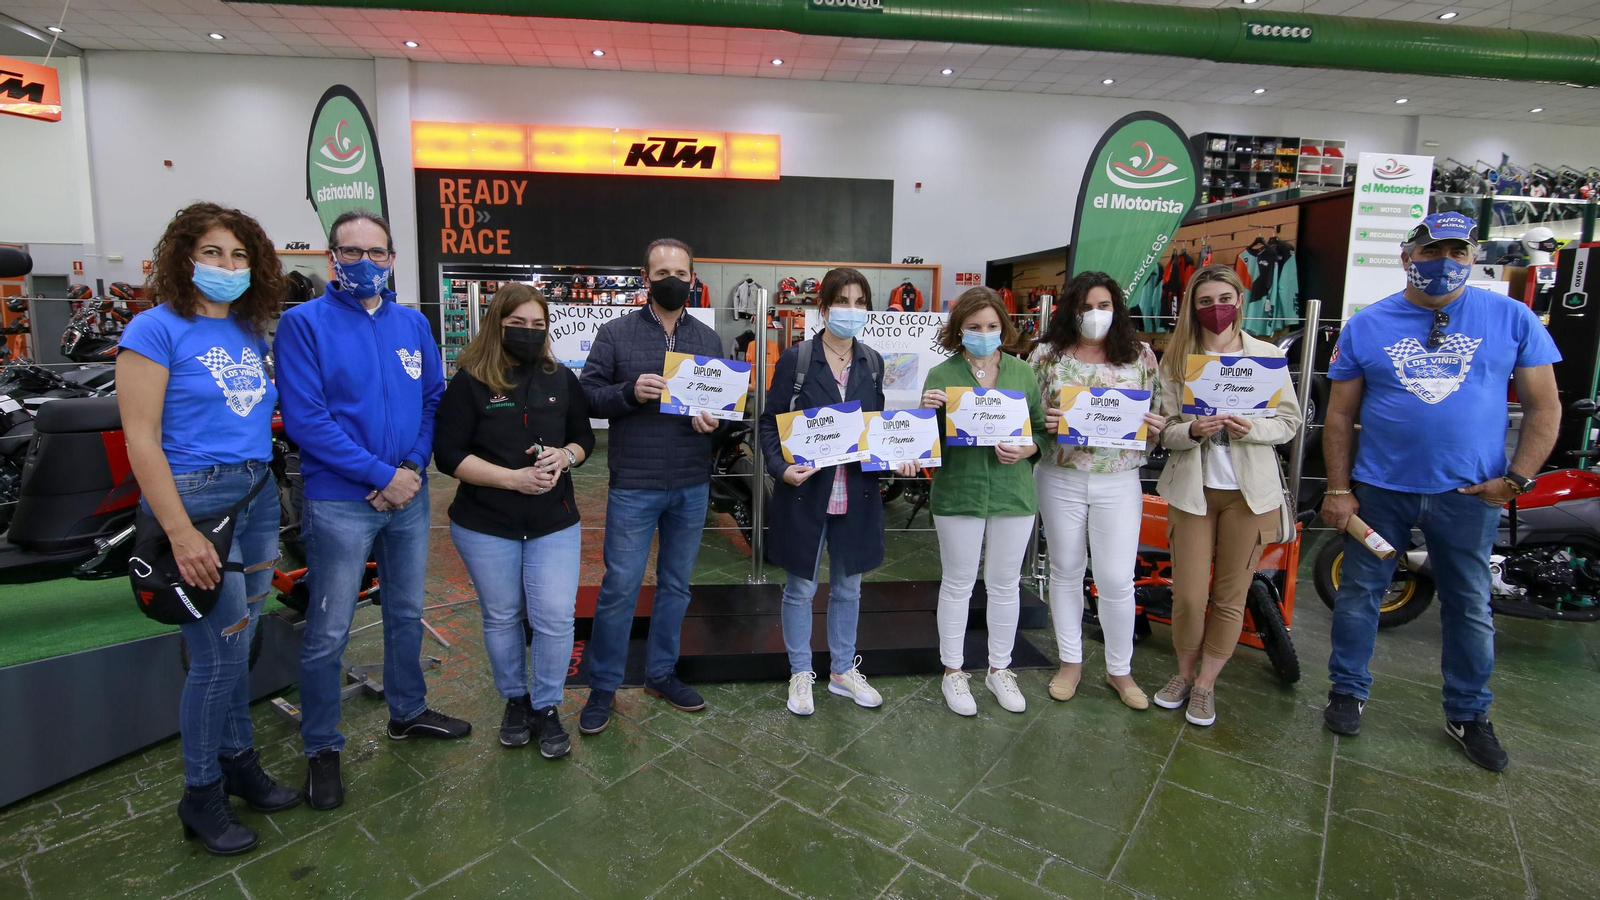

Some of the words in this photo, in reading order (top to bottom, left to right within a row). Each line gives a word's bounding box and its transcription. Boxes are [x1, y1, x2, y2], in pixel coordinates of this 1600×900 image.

[623, 136, 717, 169] KTM
[438, 178, 528, 205] READY
[1361, 182, 1372, 193] el
[1373, 183, 1425, 196] Motorista
[1093, 193, 1109, 209] el
[1110, 193, 1184, 214] Motorista
[1380, 206, 1402, 214] MOTOS
[440, 203, 476, 229] TO
[1369, 231, 1404, 239] RECAMBIOS
[285, 241, 311, 251] KTM
[441, 228, 511, 255] RACE
[902, 256, 924, 265] KTM
[1369, 257, 1400, 265] BOUTIQUE
[1574, 260, 1584, 288] OXFORD
[549, 306, 613, 324] ONCURSO
[900, 313, 944, 327] ESCOLA
[549, 321, 586, 342] IBUJO
[862, 326, 902, 338] MOTO
[907, 326, 924, 338] GP
[1405, 358, 1427, 368] LOS
[1430, 357, 1459, 365] VINIS
[223, 369, 239, 379] LOS
[693, 365, 722, 378] DIPLOMA
[1220, 366, 1253, 377] DIPLOMA
[695, 382, 724, 393] Premio
[1223, 383, 1255, 393] Premio
[1410, 381, 1435, 401] JEREZ
[231, 394, 245, 414] JEREZ
[975, 396, 1002, 406] DIPLOMA
[1090, 397, 1120, 407] DIPLOMA
[979, 411, 1007, 421] Premio
[1093, 412, 1122, 423] Premio
[806, 415, 835, 429] DIPLOMA
[883, 419, 910, 430] DIPLOMA
[813, 431, 841, 443] Premio
[888, 435, 915, 445] Premio
